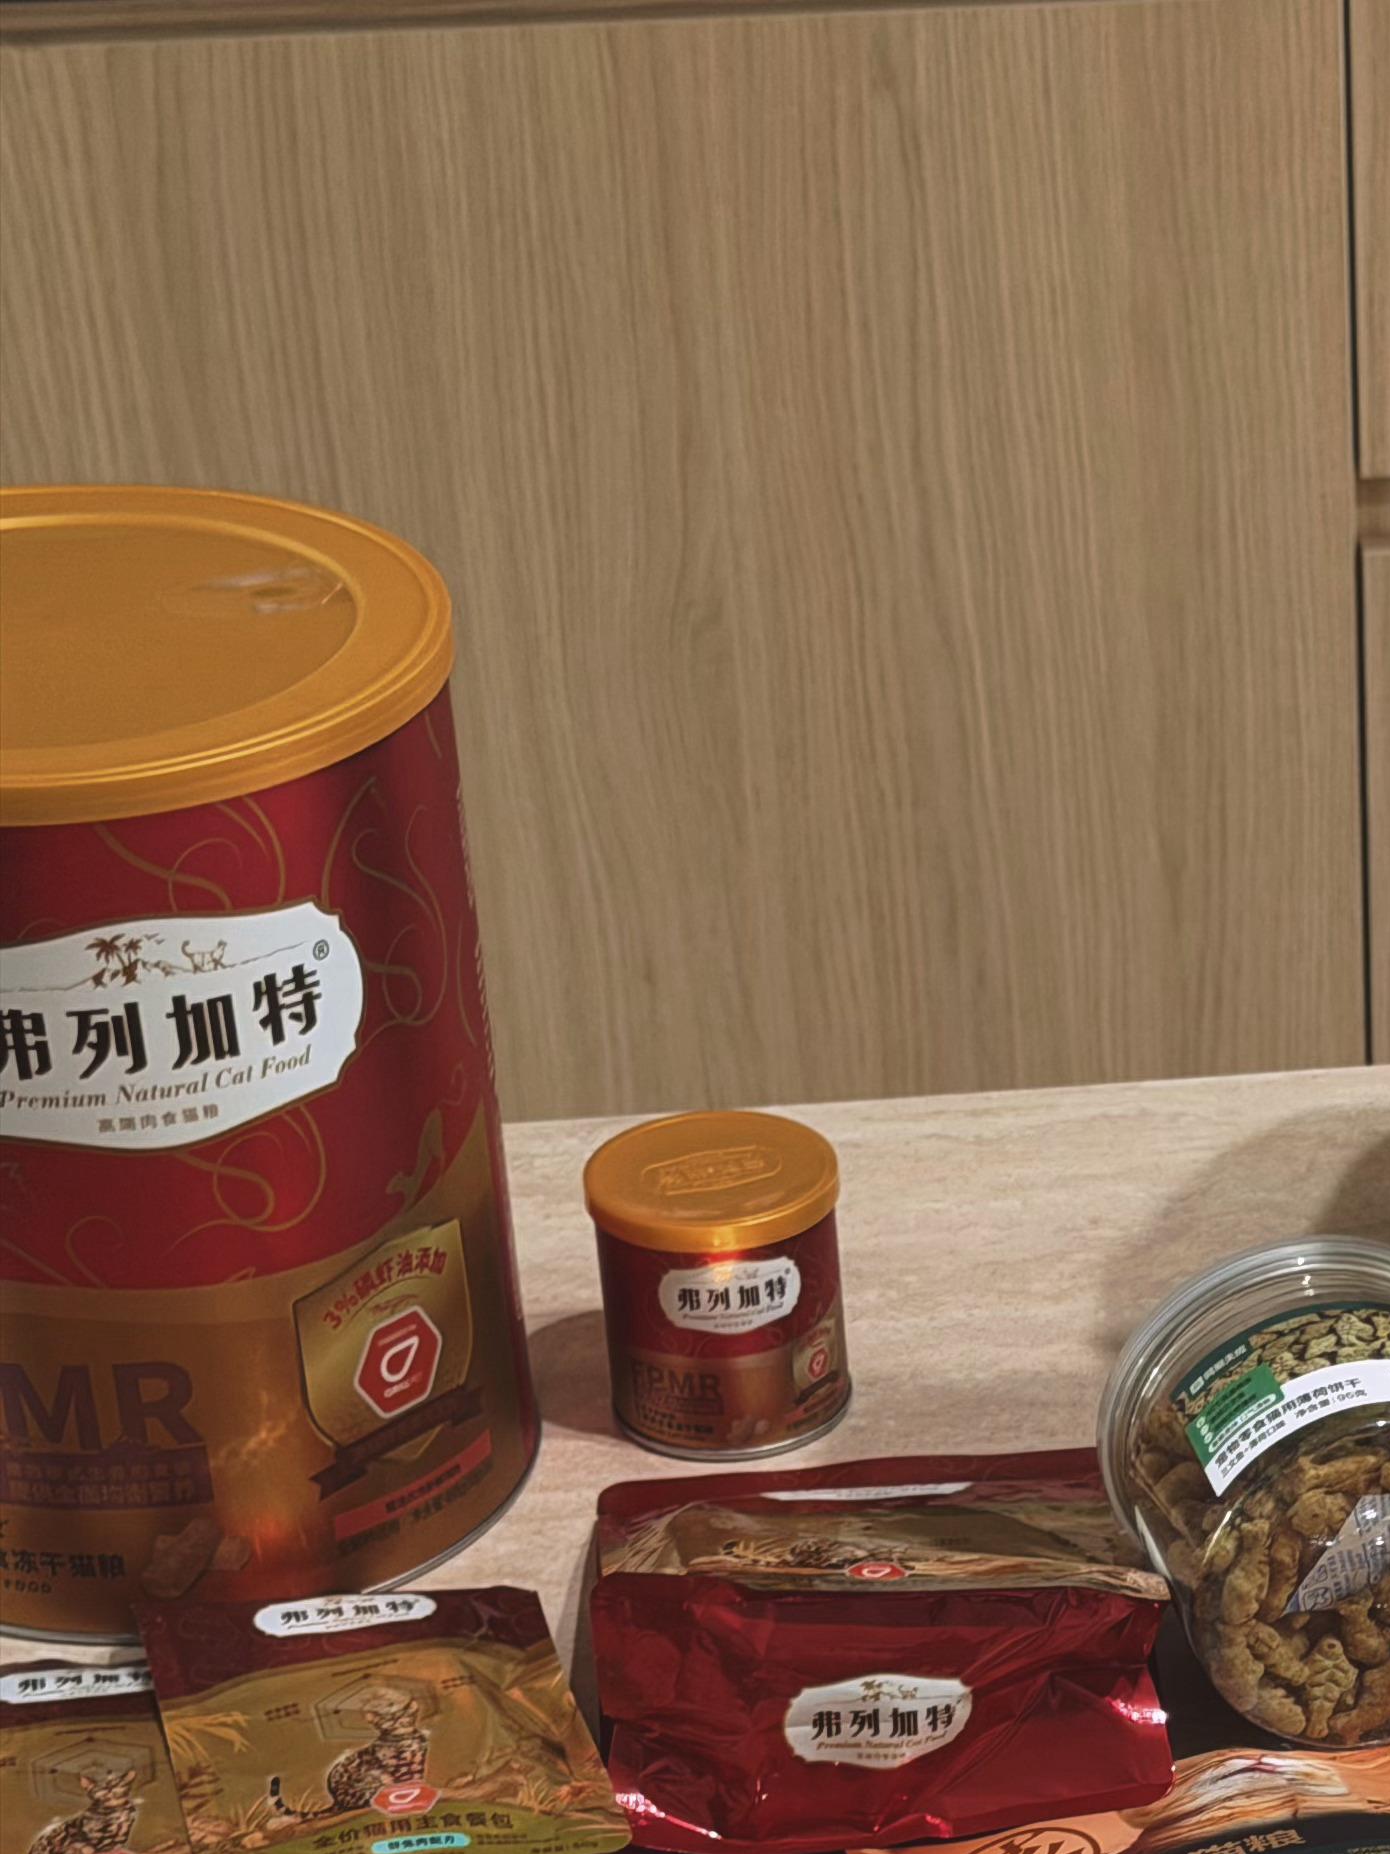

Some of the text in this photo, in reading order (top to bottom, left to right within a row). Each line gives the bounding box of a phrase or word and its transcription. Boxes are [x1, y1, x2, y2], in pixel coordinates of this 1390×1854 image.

[0, 963, 322, 1081] 弗列加特
[116, 1072, 208, 1104] Natural
[215, 1063, 252, 1088] Cat
[261, 1044, 312, 1079] Food
[677, 1275, 787, 1313] 弗列加特
[0, 1549, 127, 1578] 冻干猫粮
[811, 1703, 956, 1740] 弗列加特
